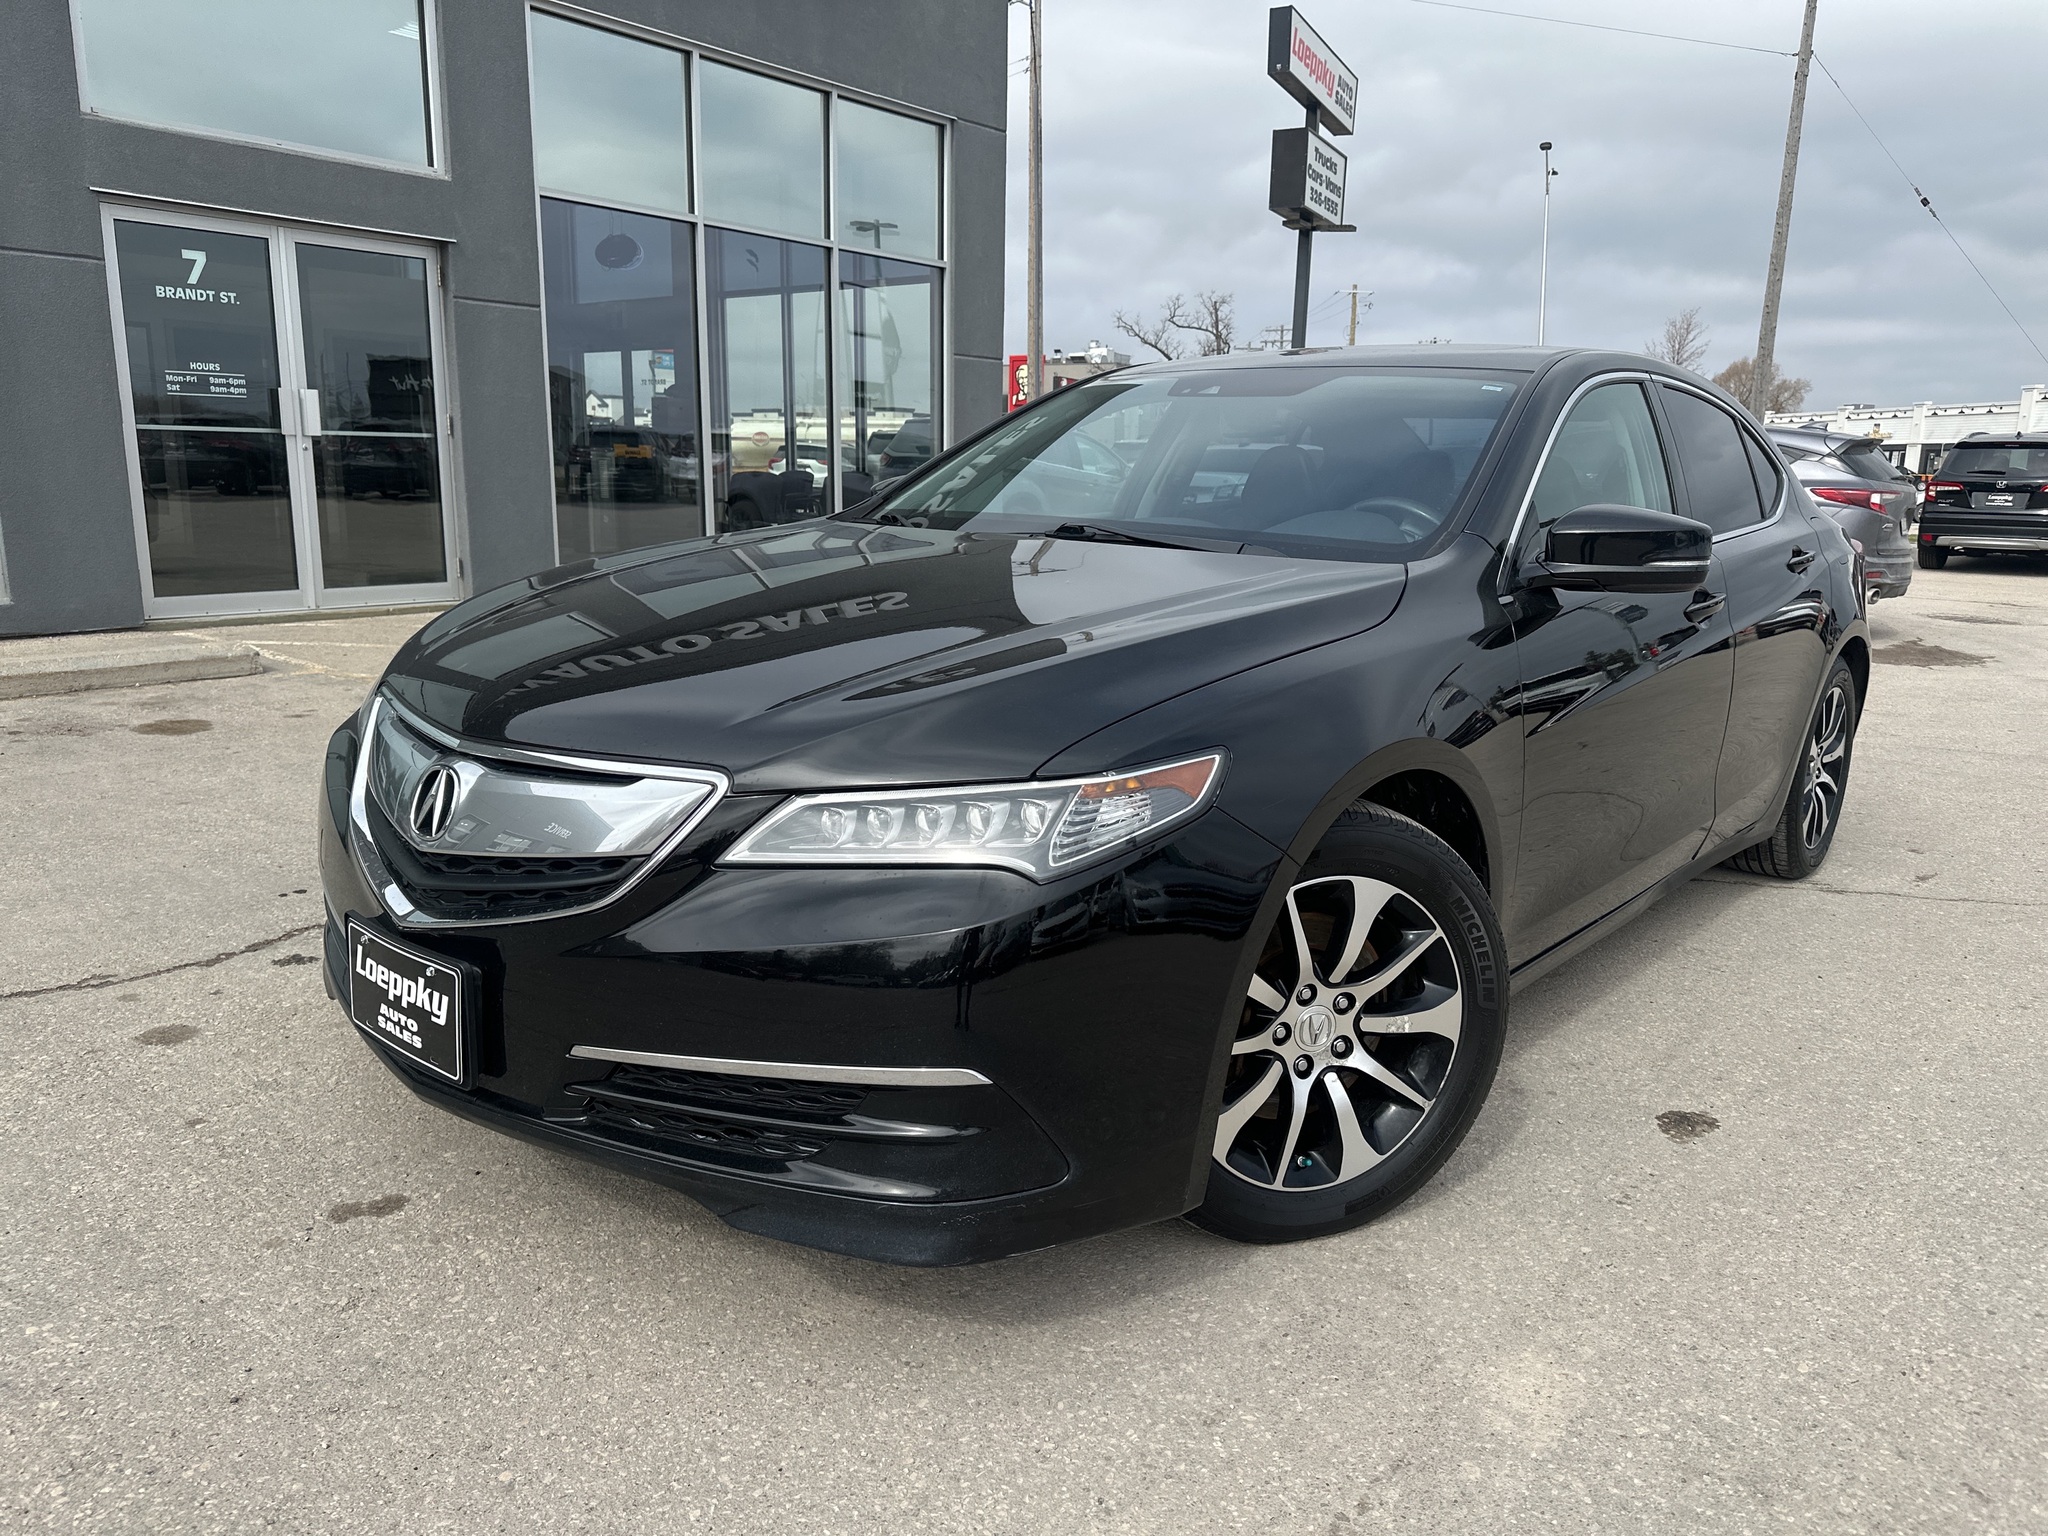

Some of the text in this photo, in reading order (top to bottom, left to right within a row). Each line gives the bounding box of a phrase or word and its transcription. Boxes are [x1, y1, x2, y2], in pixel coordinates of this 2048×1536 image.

[1292, 26, 1335, 98] Loeppky
[1337, 74, 1353, 101] AUTO
[1335, 90, 1353, 119] SALES
[1314, 145, 1337, 175] Trucks
[1309, 186, 1338, 217] 326-1555
[181, 248, 207, 284] 7
[155, 285, 240, 305] BRANDT ST.
[165, 375, 246, 386] Mon-Fri 9am-6pm
[189, 362, 220, 371] HOURS
[210, 386, 247, 395] 9am-4pm
[1450, 895, 1496, 1003] MICHELIN
[355, 944, 449, 1026] Loeppky
[377, 1015, 423, 1049] SALES
[379, 1002, 418, 1032] AUTO
